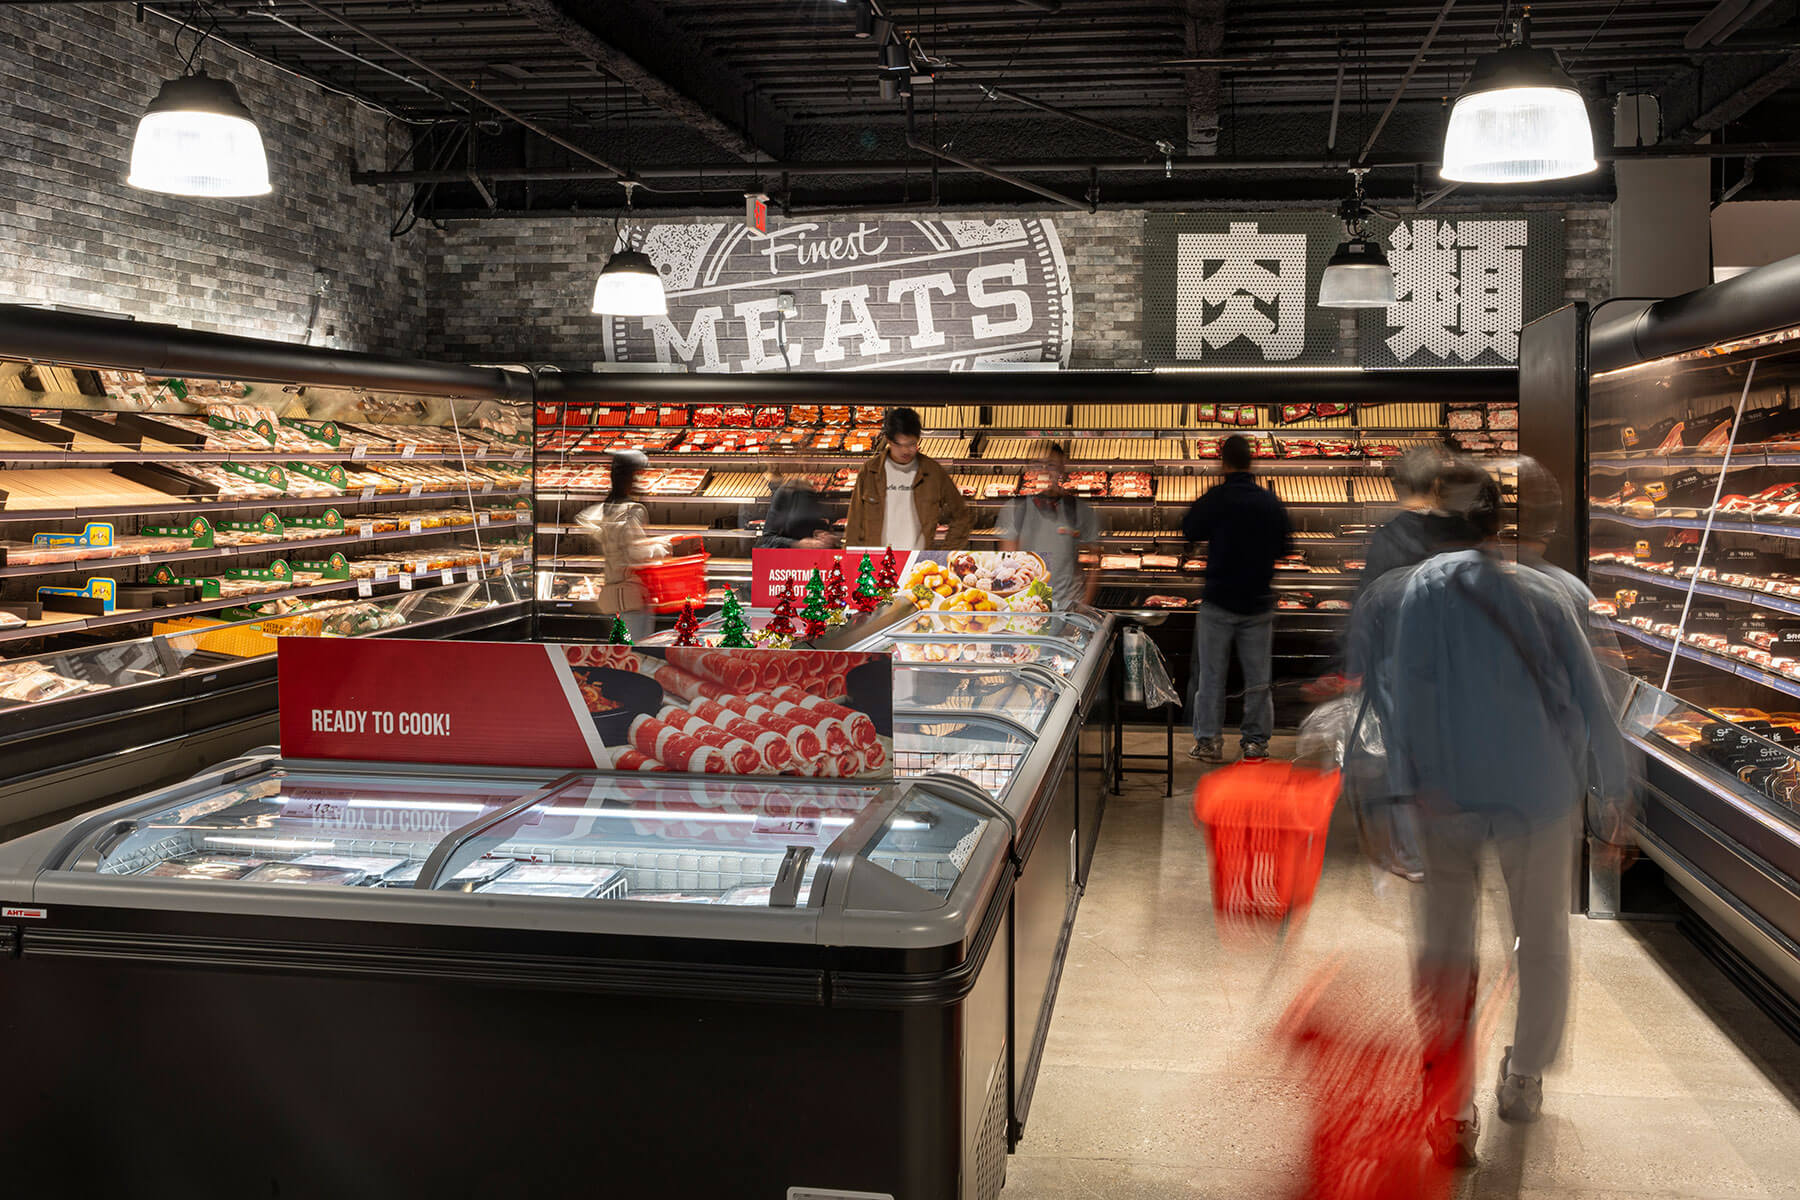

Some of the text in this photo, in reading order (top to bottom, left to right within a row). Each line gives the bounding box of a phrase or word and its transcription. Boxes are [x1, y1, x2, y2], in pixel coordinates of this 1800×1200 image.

[748, 222, 888, 275] Finest
[643, 259, 1033, 373] MEATS
[1176, 220, 1527, 362] 肉類
[312, 709, 450, 736] READY TO COOK!
